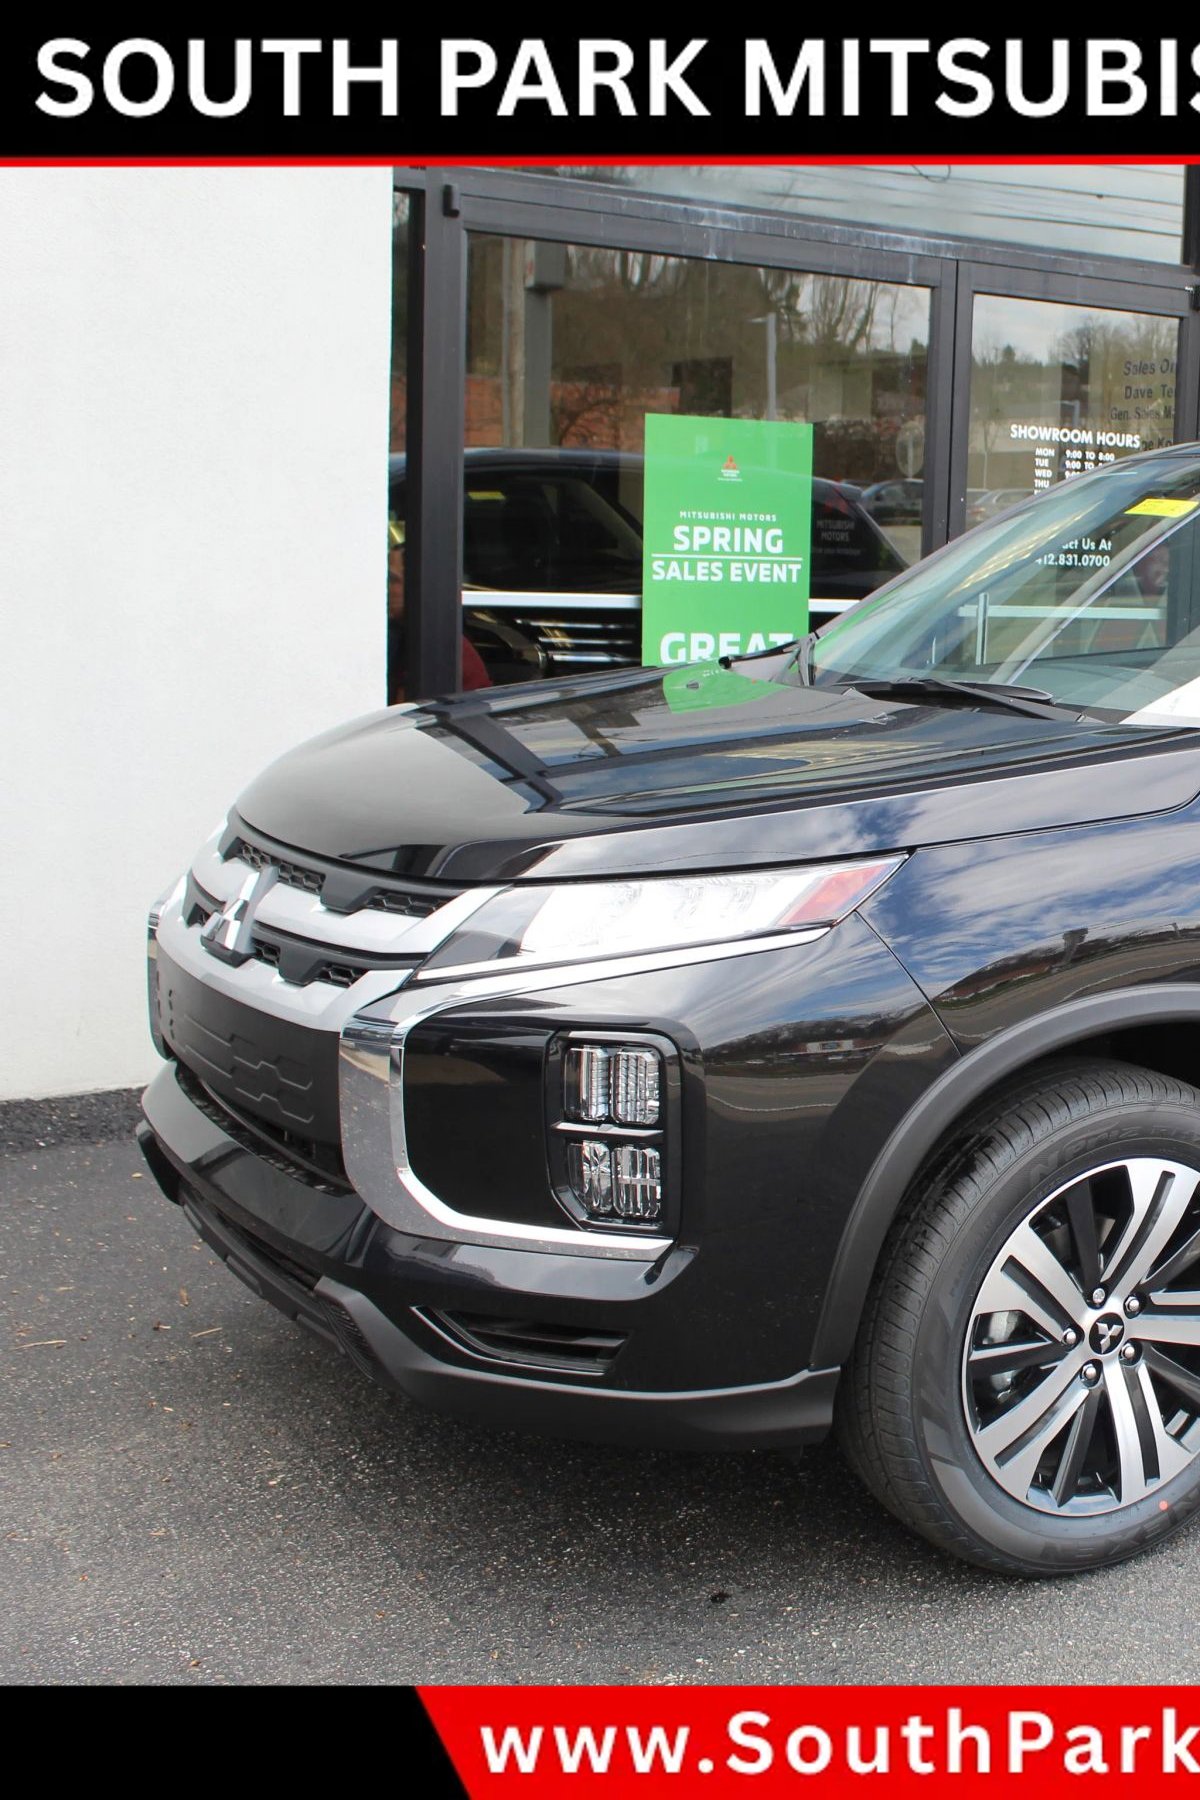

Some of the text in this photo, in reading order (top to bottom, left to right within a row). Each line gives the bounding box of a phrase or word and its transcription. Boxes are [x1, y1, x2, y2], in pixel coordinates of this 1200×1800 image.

[1124, 385, 1153, 400] Dave
[1010, 423, 1141, 449] SHOWROOM HOURS
[1035, 447, 1115, 462] MON 9:00 TO 8:00
[1035, 457, 1049, 467] TUE
[1065, 460, 1081, 470] 9:00
[1084, 462, 1095, 470] TO
[1035, 468, 1053, 478] WED
[1034, 479, 1049, 488] THU
[680, 511, 776, 522] MITSUBISHI MOTORS
[673, 525, 783, 553] SPRING
[1082, 538, 1095, 550] Us
[1099, 538, 1112, 550] At
[652, 560, 802, 583] SALES EVENT
